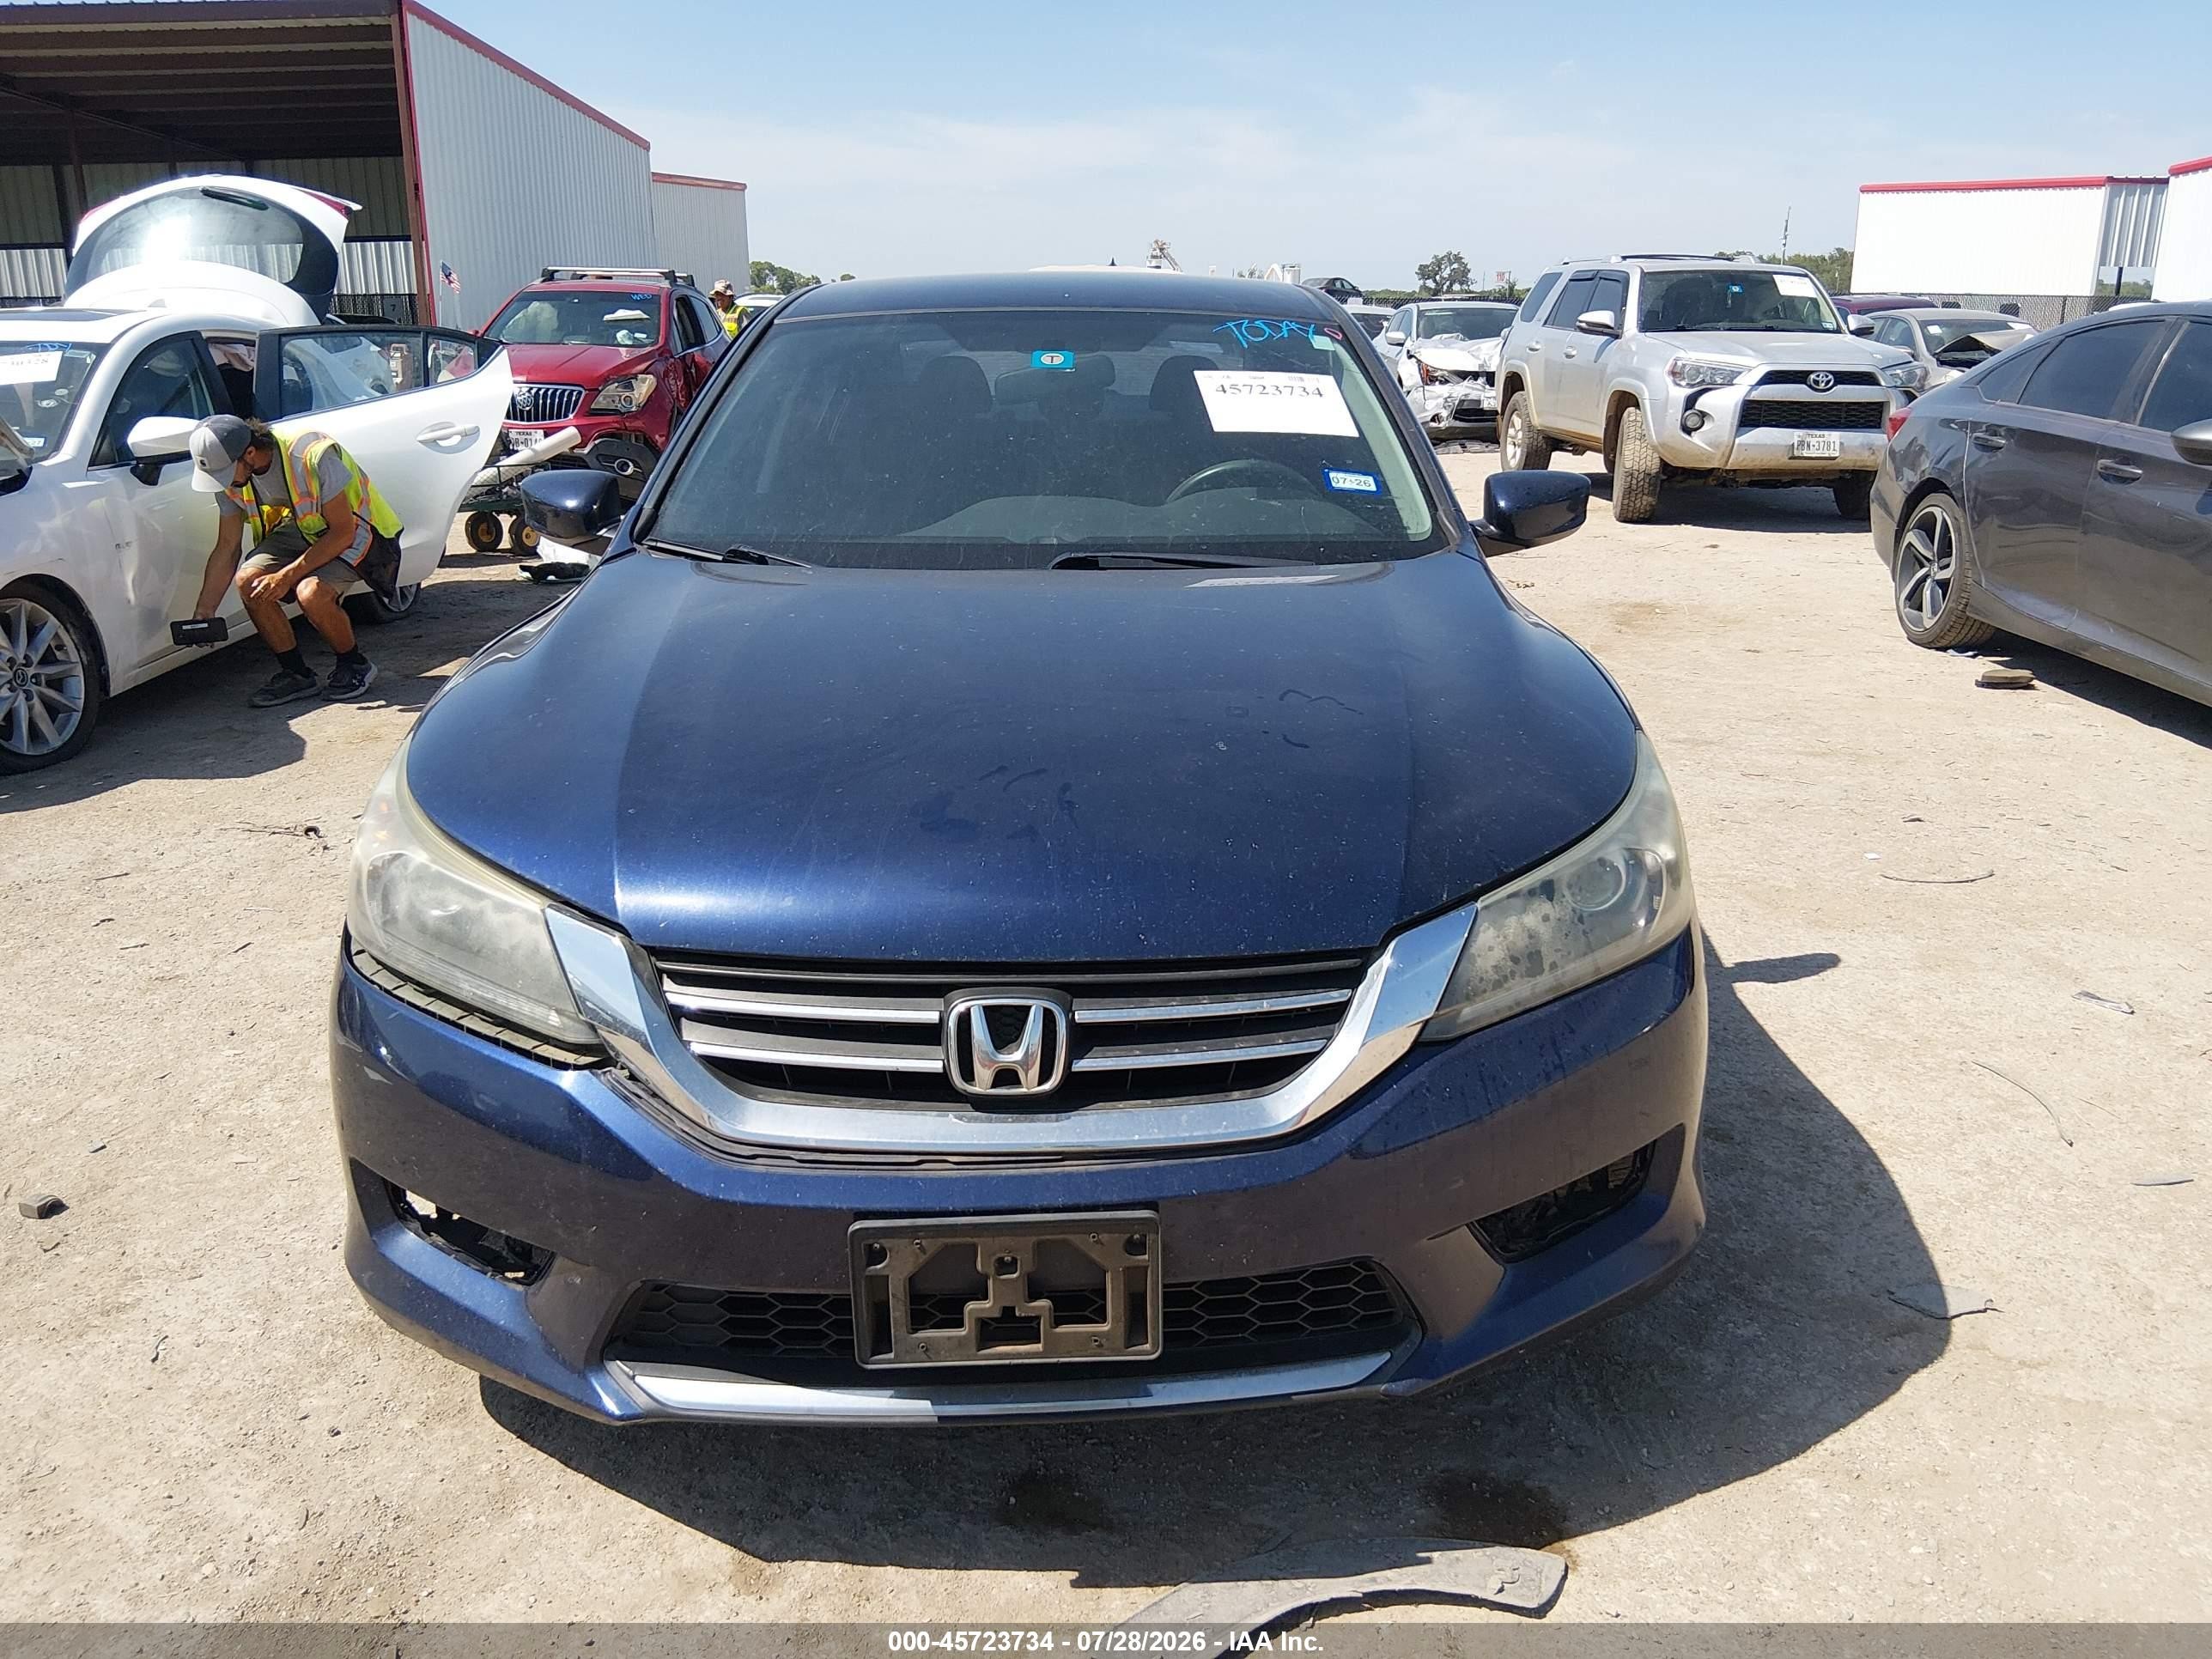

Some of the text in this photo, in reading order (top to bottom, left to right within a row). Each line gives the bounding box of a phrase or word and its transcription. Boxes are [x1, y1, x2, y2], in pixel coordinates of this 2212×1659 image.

[1212, 320, 1316, 349] TODAY
[1215, 384, 1324, 398] 45723734
[1796, 440, 1837, 452] PBN-3781
